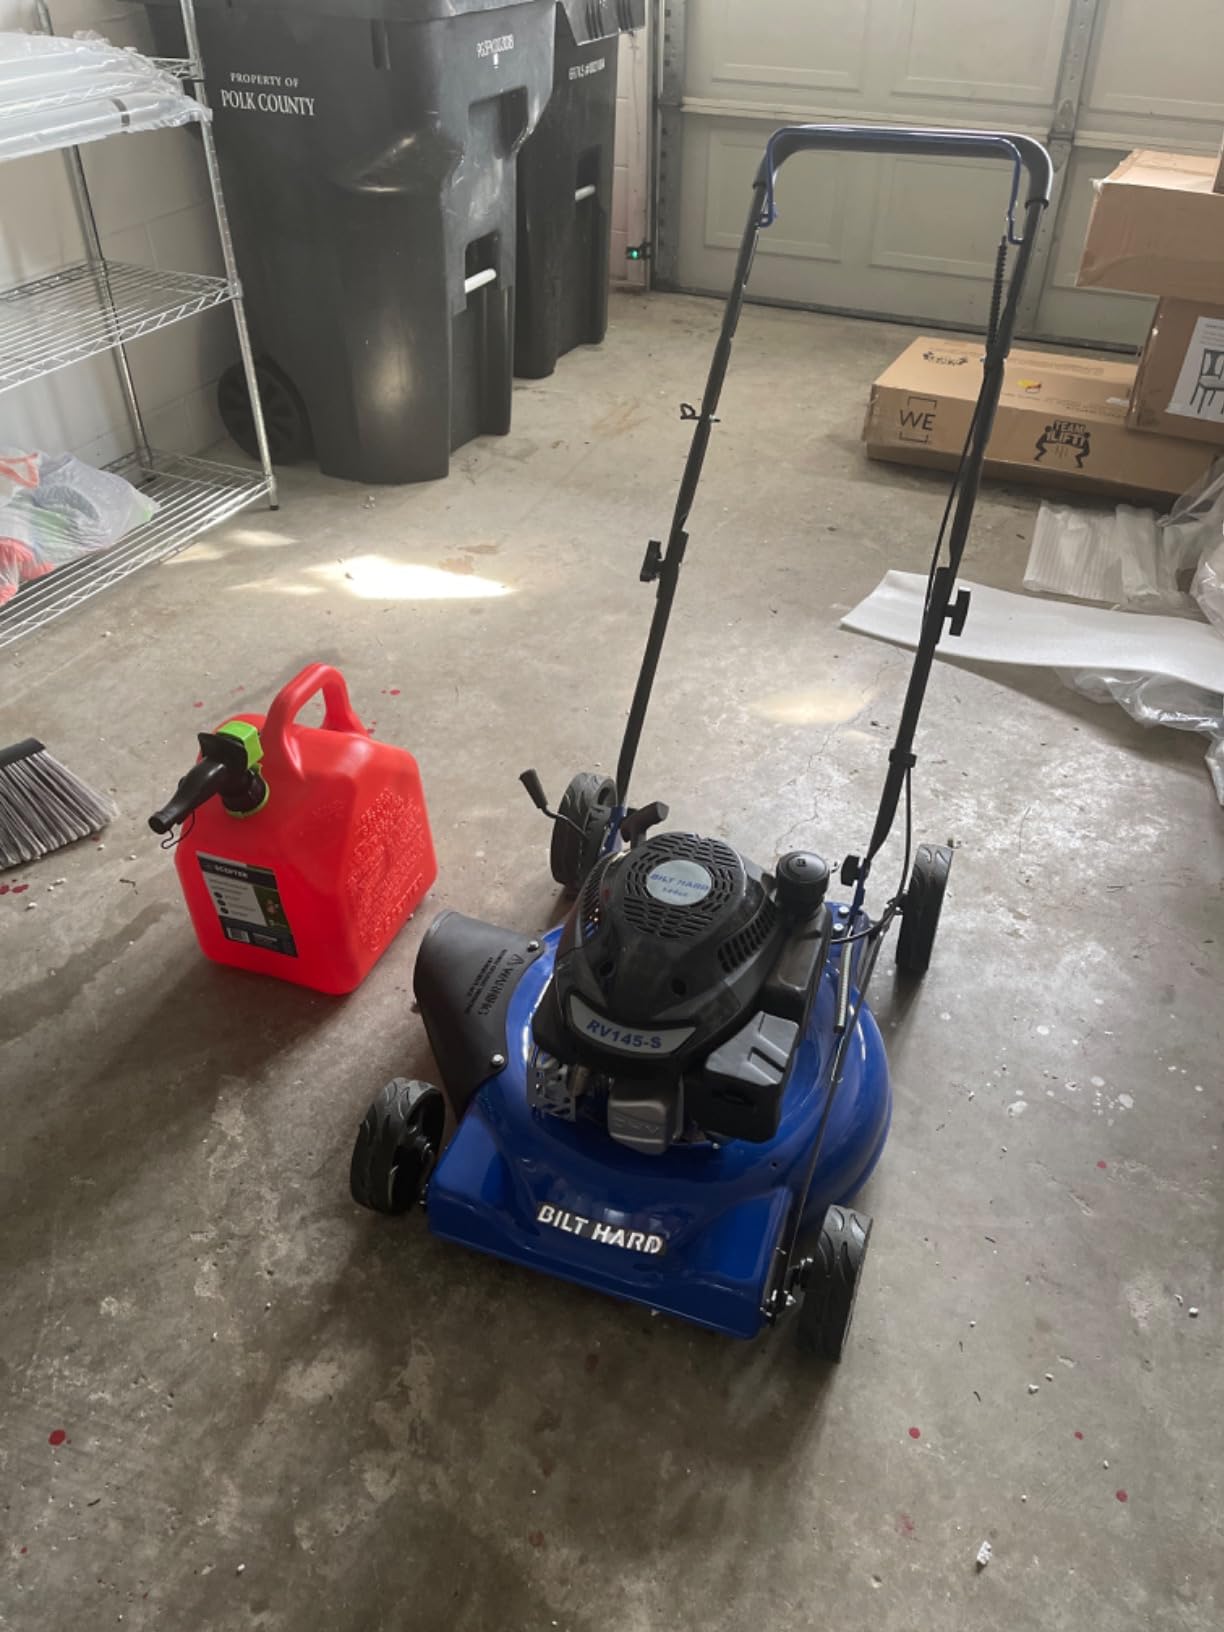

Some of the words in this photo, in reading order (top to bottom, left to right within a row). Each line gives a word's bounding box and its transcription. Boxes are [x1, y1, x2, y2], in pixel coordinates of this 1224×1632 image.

[230, 72, 281, 87] PROPERTY
[284, 76, 299, 88] OF
[220, 89, 256, 110] POLK
[257, 93, 315, 116] COUNTY
[899, 409, 936, 431] WE
[1053, 420, 1086, 434] TEAM
[650, 872, 675, 883] BILT
[676, 879, 709, 891] HARD
[586, 1019, 662, 1049] RV145-S
[537, 1204, 589, 1236] BILT
[591, 1222, 663, 1255] HARD
